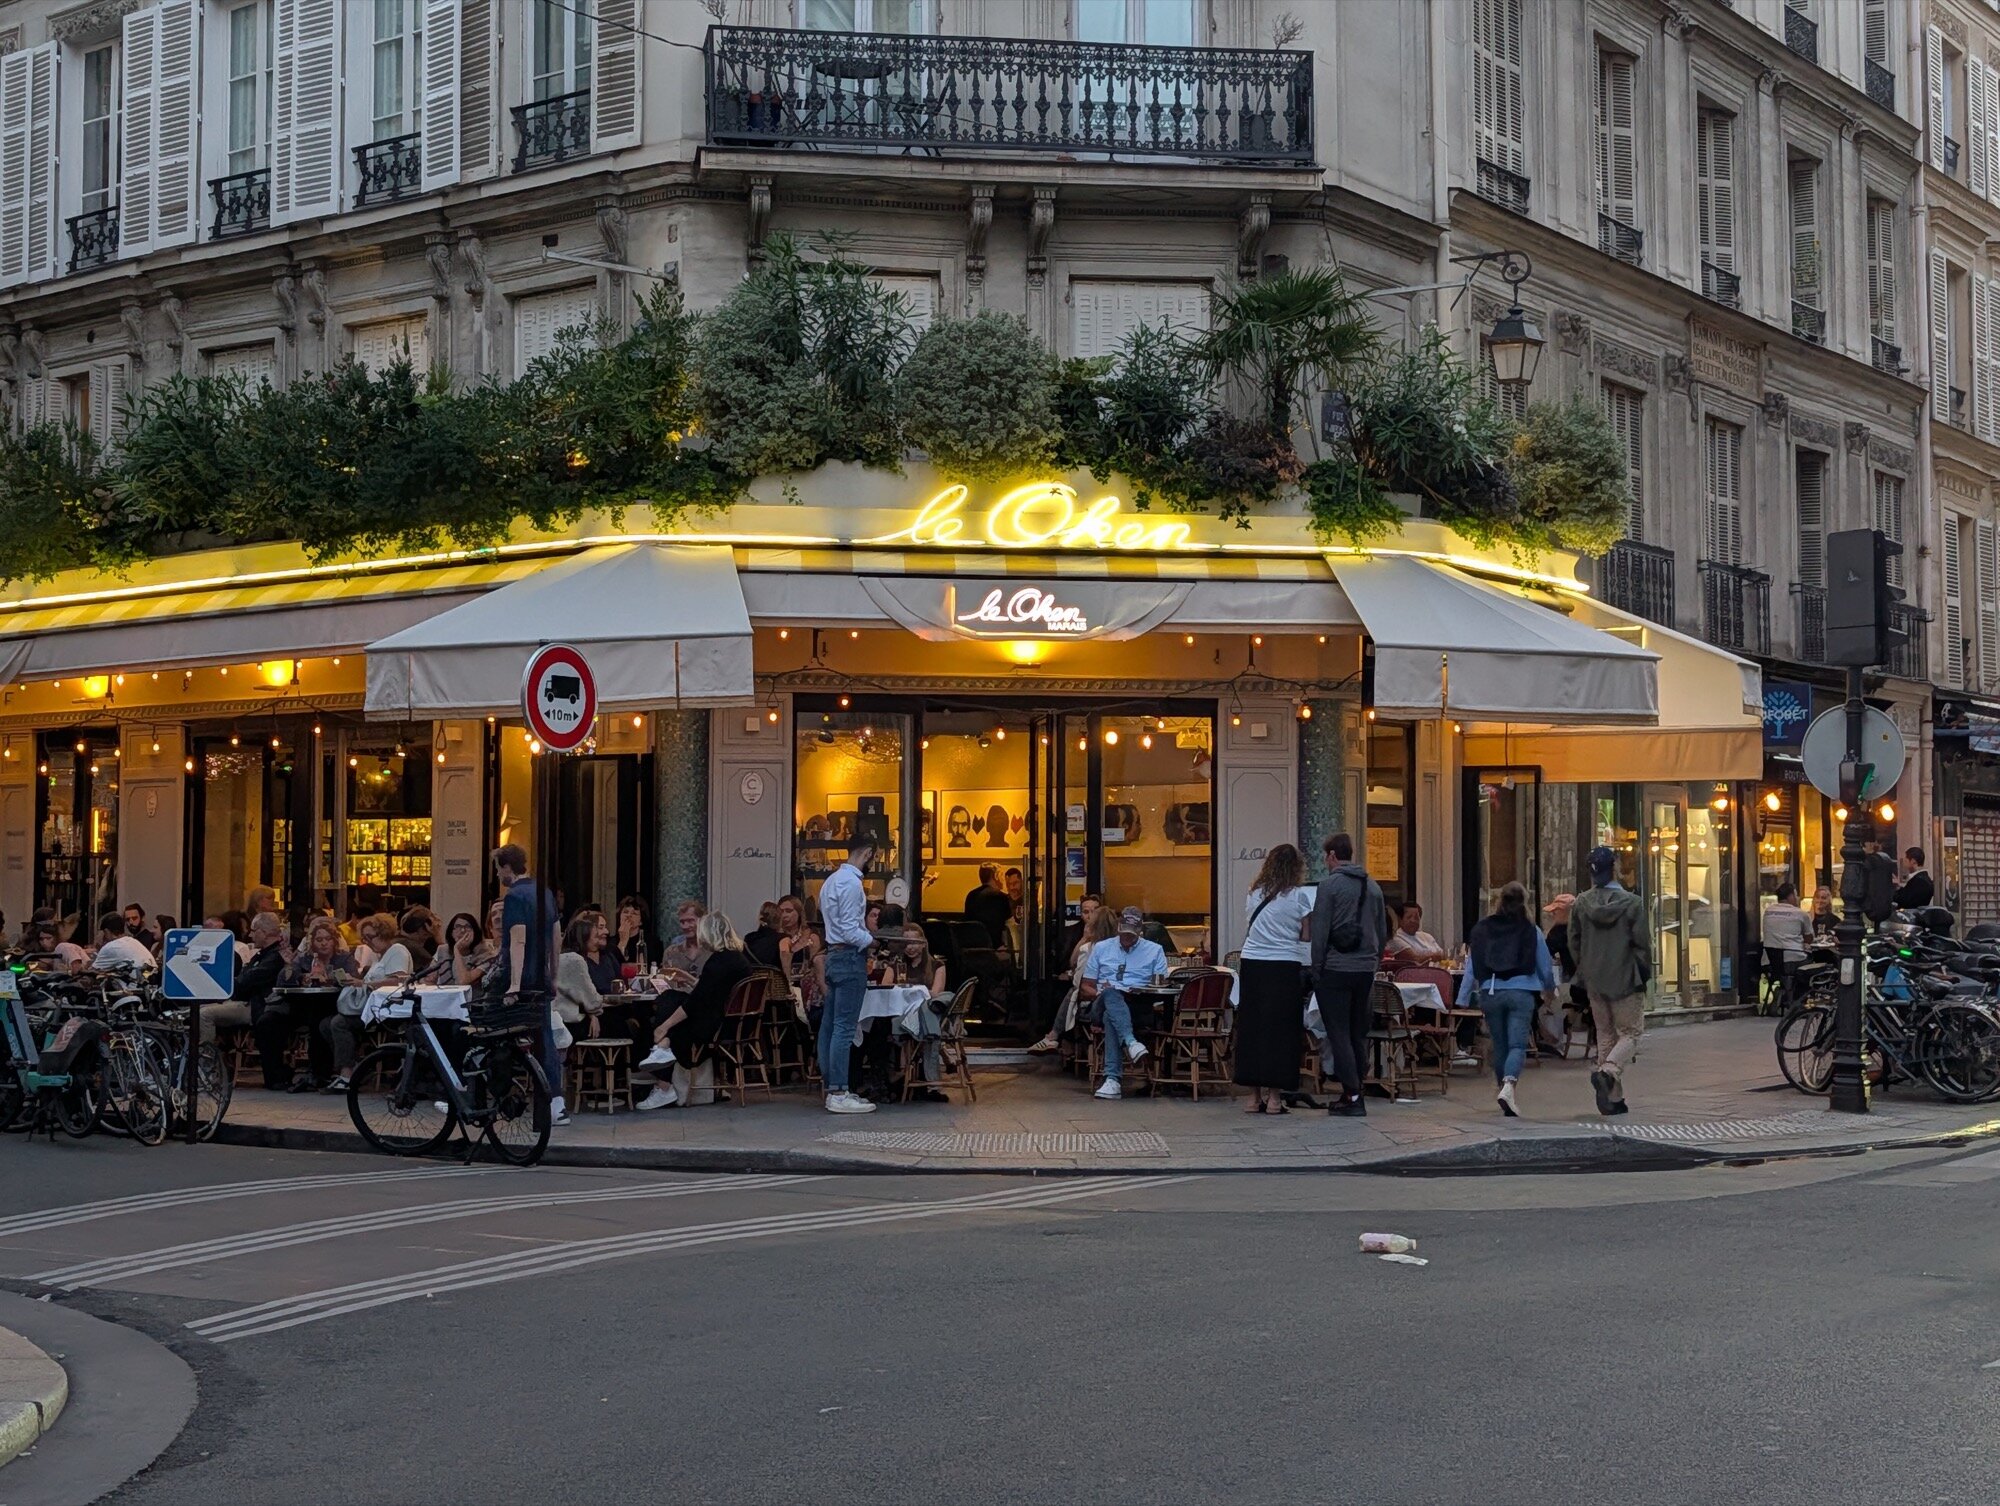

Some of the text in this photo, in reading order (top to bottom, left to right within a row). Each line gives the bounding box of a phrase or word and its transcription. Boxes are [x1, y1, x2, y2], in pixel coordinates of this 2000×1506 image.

[853, 484, 986, 546] le
[957, 589, 1009, 623] le
[1047, 621, 1087, 632] MARAIS
[551, 709, 572, 721] 10m
